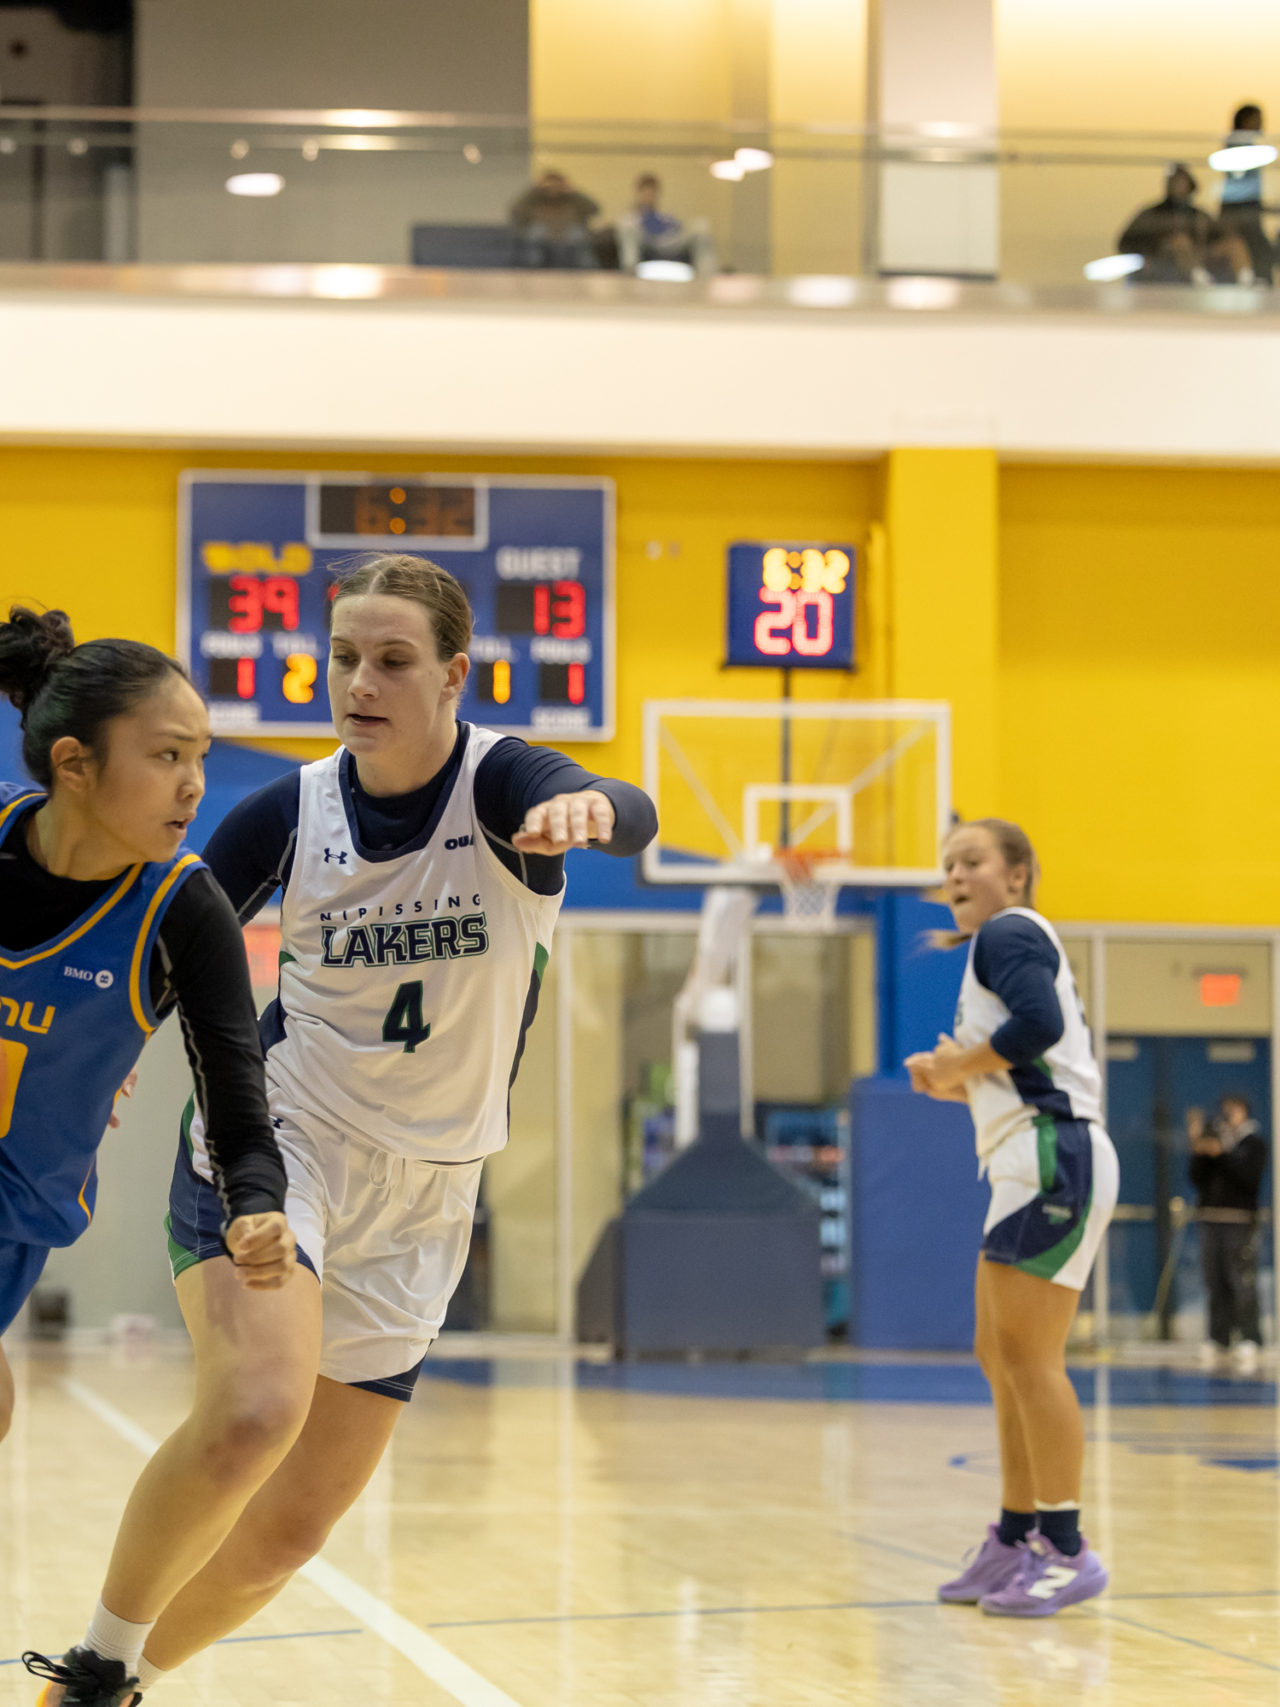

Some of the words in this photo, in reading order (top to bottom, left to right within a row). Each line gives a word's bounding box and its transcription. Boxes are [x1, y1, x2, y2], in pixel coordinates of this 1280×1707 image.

[228, 575, 300, 634] 39
[532, 580, 587, 640] 13
[754, 583, 834, 656] 20
[236, 657, 255, 700] 1
[282, 653, 318, 703] 2
[567, 662, 585, 705] 1
[320, 893, 481, 922] NIPISSING
[321, 912, 489, 968] LAKERS
[63, 966, 94, 981] BMO
[382, 980, 431, 1054] 4
